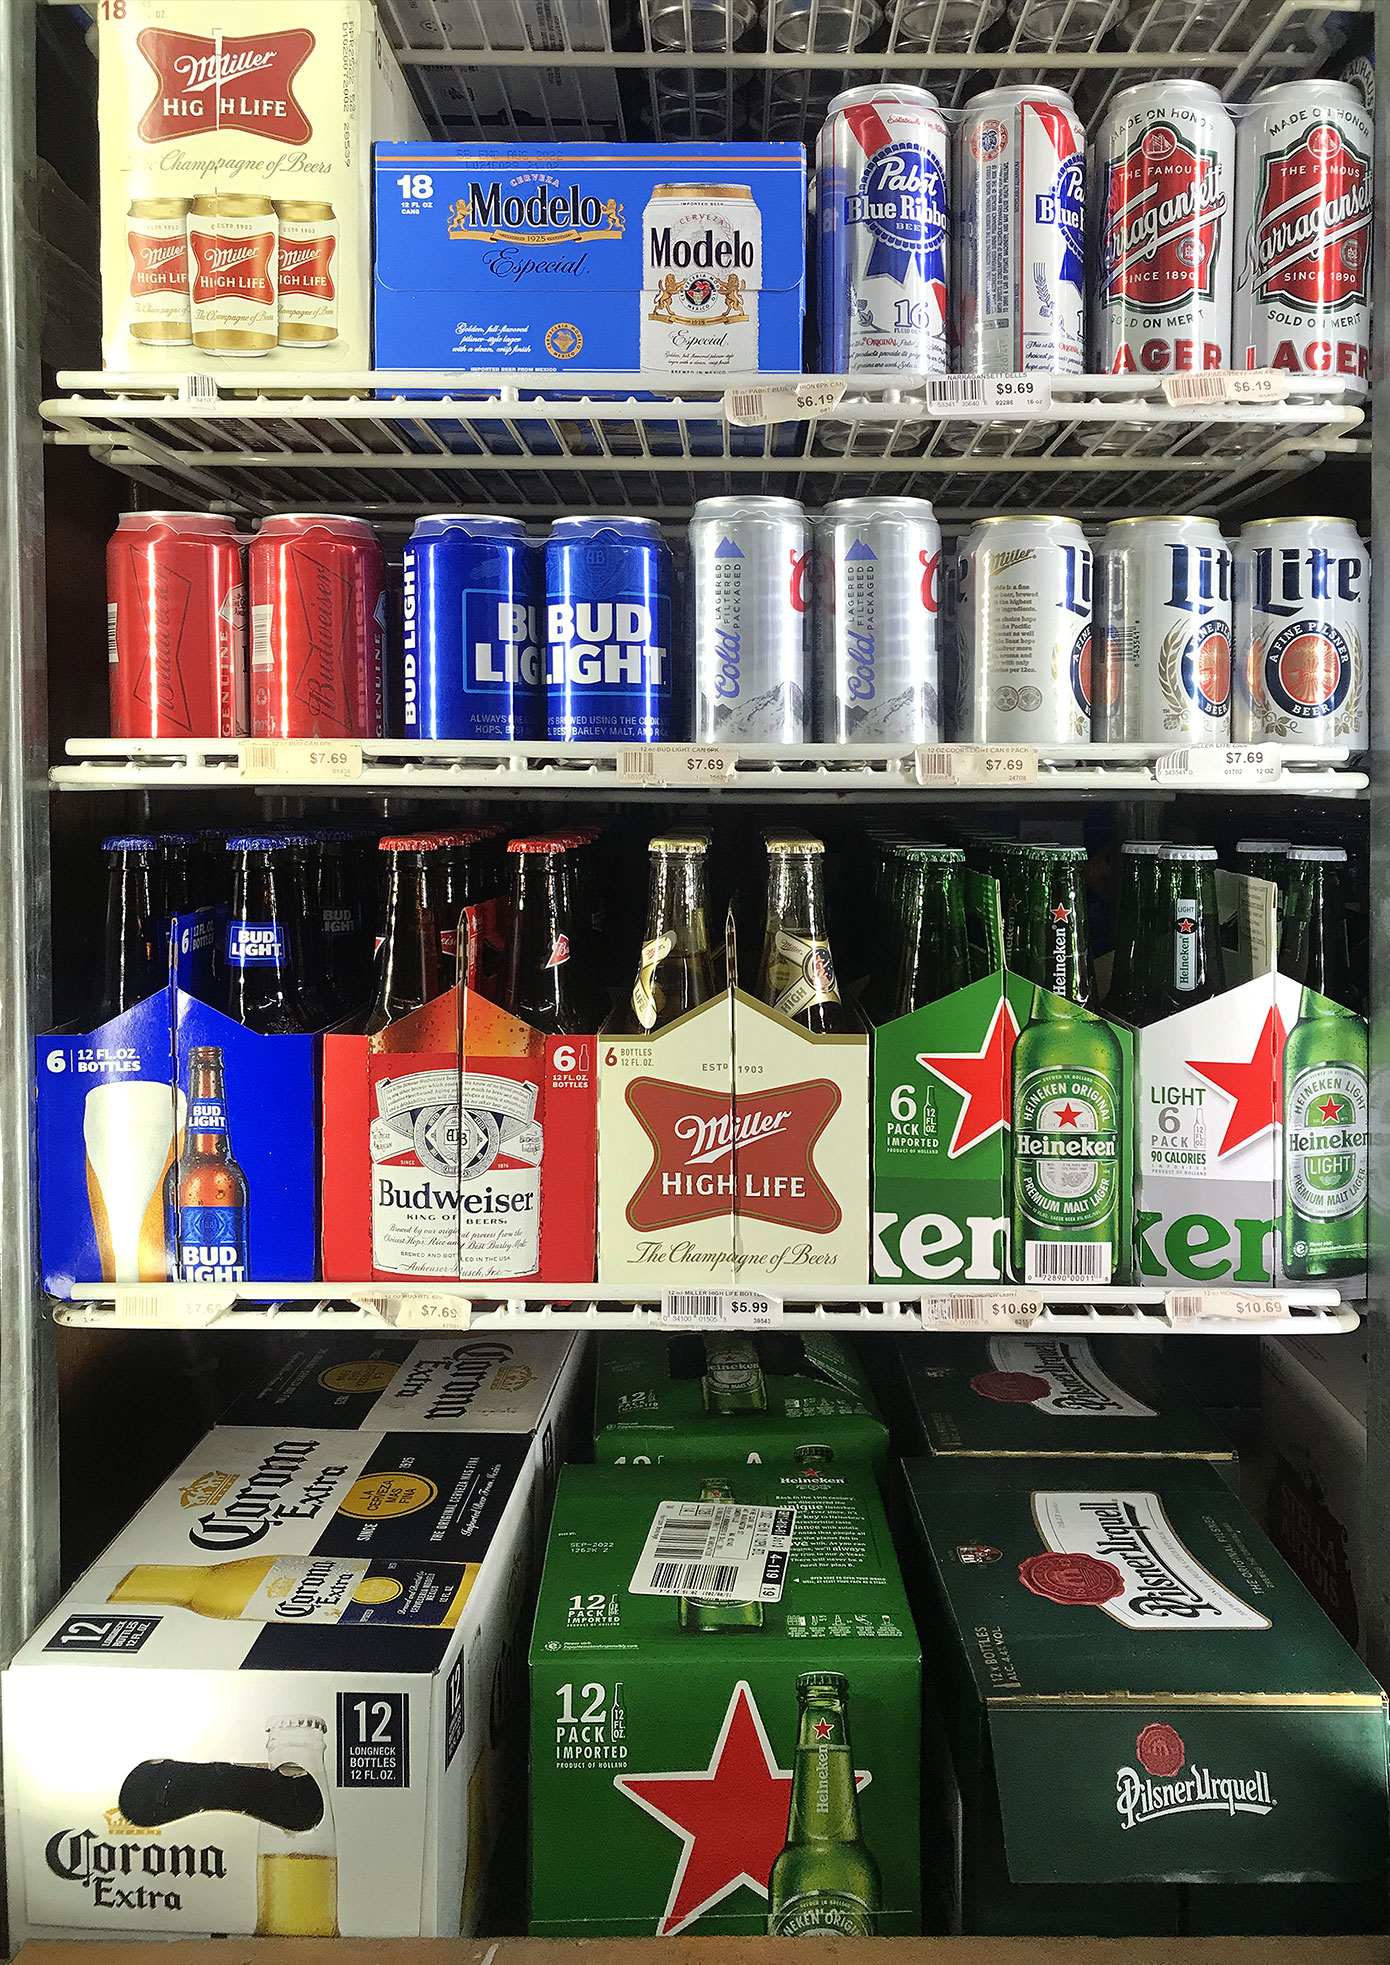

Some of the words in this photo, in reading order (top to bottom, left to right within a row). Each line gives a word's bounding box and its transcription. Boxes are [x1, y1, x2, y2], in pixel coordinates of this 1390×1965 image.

[101, 0, 128, 20] 18
[240, 97, 288, 117] LIFE
[1147, 108, 1166, 119] ON
[510, 173, 559, 188] CERVEZA
[877, 156, 938, 197] Pabst
[1119, 166, 1142, 181] THE
[1280, 166, 1307, 177] THE
[1312, 165, 1361, 178] FAMOUS
[397, 173, 434, 200] 18
[468, 182, 602, 227] Modelo
[1038, 196, 1079, 227] Blue
[679, 213, 725, 226] CERVEZA
[896, 222, 929, 233] BEER
[650, 226, 755, 269] Modelo
[140, 245, 187, 271] Miller
[204, 246, 260, 274] Miller
[200, 276, 237, 289] HIGH
[239, 277, 266, 290] LIFE
[1122, 272, 1158, 285] SINCE
[1166, 271, 1196, 281] 1890
[894, 299, 930, 330] 16
[996, 382, 1034, 396] $9.69
[1233, 380, 1272, 394] $6.19
[797, 393, 835, 409] $6.19
[1252, 547, 1361, 618] Lite
[866, 565, 875, 631] PACKAGED
[547, 603, 652, 643] BUD
[307, 564, 335, 719] Budweiser
[714, 628, 742, 699] Cold
[847, 629, 876, 701] Cold
[220, 630, 232, 738] GENUINE
[375, 633, 385, 738] GENUINE
[1204, 702, 1228, 715] BEER
[1291, 702, 1331, 718] BEER
[470, 714, 507, 723] ALWAYS
[572, 727, 607, 736] BARLEY
[609, 727, 635, 738] MALT,
[310, 752, 348, 765] $7.69
[687, 758, 724, 771] $7.69
[986, 758, 1023, 771] $7.69
[1226, 752, 1263, 764] $7.69
[323, 909, 351, 922] BUD
[1177, 905, 1195, 914] LIGHT
[181, 928, 190, 954] 6
[238, 930, 275, 944] BUD
[781, 939, 803, 957] Miller
[1052, 926, 1067, 998] Heineken
[1178, 936, 1190, 985] Heineken
[553, 1045, 576, 1072] 6
[604, 1046, 618, 1067] 6
[620, 1048, 653, 1057] BOTTLES
[77, 1060, 141, 1073] BOTTLES
[552, 1081, 589, 1089] BOTTLES
[889, 1084, 918, 1122] 6
[1023, 1083, 1067, 1122] HEINEKEN
[1071, 1083, 1112, 1123] ORIGINAL
[1150, 1086, 1207, 1106] LIGHT
[193, 1105, 222, 1116] BUD
[188, 1116, 226, 1128] LIGHT
[887, 1122, 919, 1137] PACK
[1158, 1107, 1181, 1134] 6
[674, 1110, 792, 1166] Miller
[886, 1137, 940, 1148] IMPORTED
[1016, 1134, 1115, 1157] Heineken
[1151, 1135, 1189, 1148] PACK
[1151, 1150, 1163, 1163] 90
[1164, 1151, 1207, 1165] CALORIES
[661, 1172, 738, 1197] HIGH
[745, 1174, 806, 1198] LIFE
[379, 1179, 535, 1215] Budweiser
[1023, 1176, 1061, 1214] PREMIUM
[1063, 1200, 1090, 1214] MALT
[1091, 1178, 1111, 1207] LAGER
[406, 1213, 437, 1221] KING
[182, 1246, 238, 1267] BUD
[627, 1240, 667, 1265] The
[668, 1241, 767, 1273] Champagne
[765, 1245, 786, 1274] of
[784, 1243, 838, 1266] Beers
[172, 1265, 246, 1283] LIGHT
[1042, 1274, 1068, 1282] 72890
[1069, 1274, 1095, 1282] 00011
[421, 1304, 459, 1319] $7.69
[731, 1301, 768, 1314] $5.99
[992, 1302, 1037, 1316] $10.69
[1236, 1301, 1282, 1314] $10.69
[393, 1358, 451, 1399] Extra
[423, 1342, 515, 1421] Corona
[617, 1391, 646, 1404] 12
[779, 1476, 846, 1485] Heineken
[188, 1439, 321, 1552] Corona
[269, 1464, 349, 1527] Extra
[1079, 1501, 1150, 1557] Urquell
[765, 1553, 783, 1580] 4-119
[761, 1586, 777, 1598] 19
[1127, 1553, 1222, 1621] Pilsner
[569, 1594, 607, 1611] 12
[567, 1610, 605, 1618] PACK
[60, 1621, 111, 1644] 12
[112, 1620, 139, 1648] BOTTLES
[976, 1626, 998, 1665] BOTTLES
[989, 1672, 1003, 1682] 12
[555, 1682, 607, 1723] 12
[353, 1700, 393, 1743] 12
[556, 1726, 605, 1743] PACK
[349, 1746, 397, 1756] LONGNECK
[556, 1745, 628, 1759] IMPORTED
[349, 1757, 397, 1768] BOTTLES
[598, 1761, 628, 1769] HOLLAND
[816, 1743, 830, 1814] Heineken
[1116, 1765, 1194, 1830] Pilsner
[1190, 1764, 1273, 1817] Urquell
[44, 1828, 228, 1882] Corona
[86, 1875, 184, 1912] Extra
